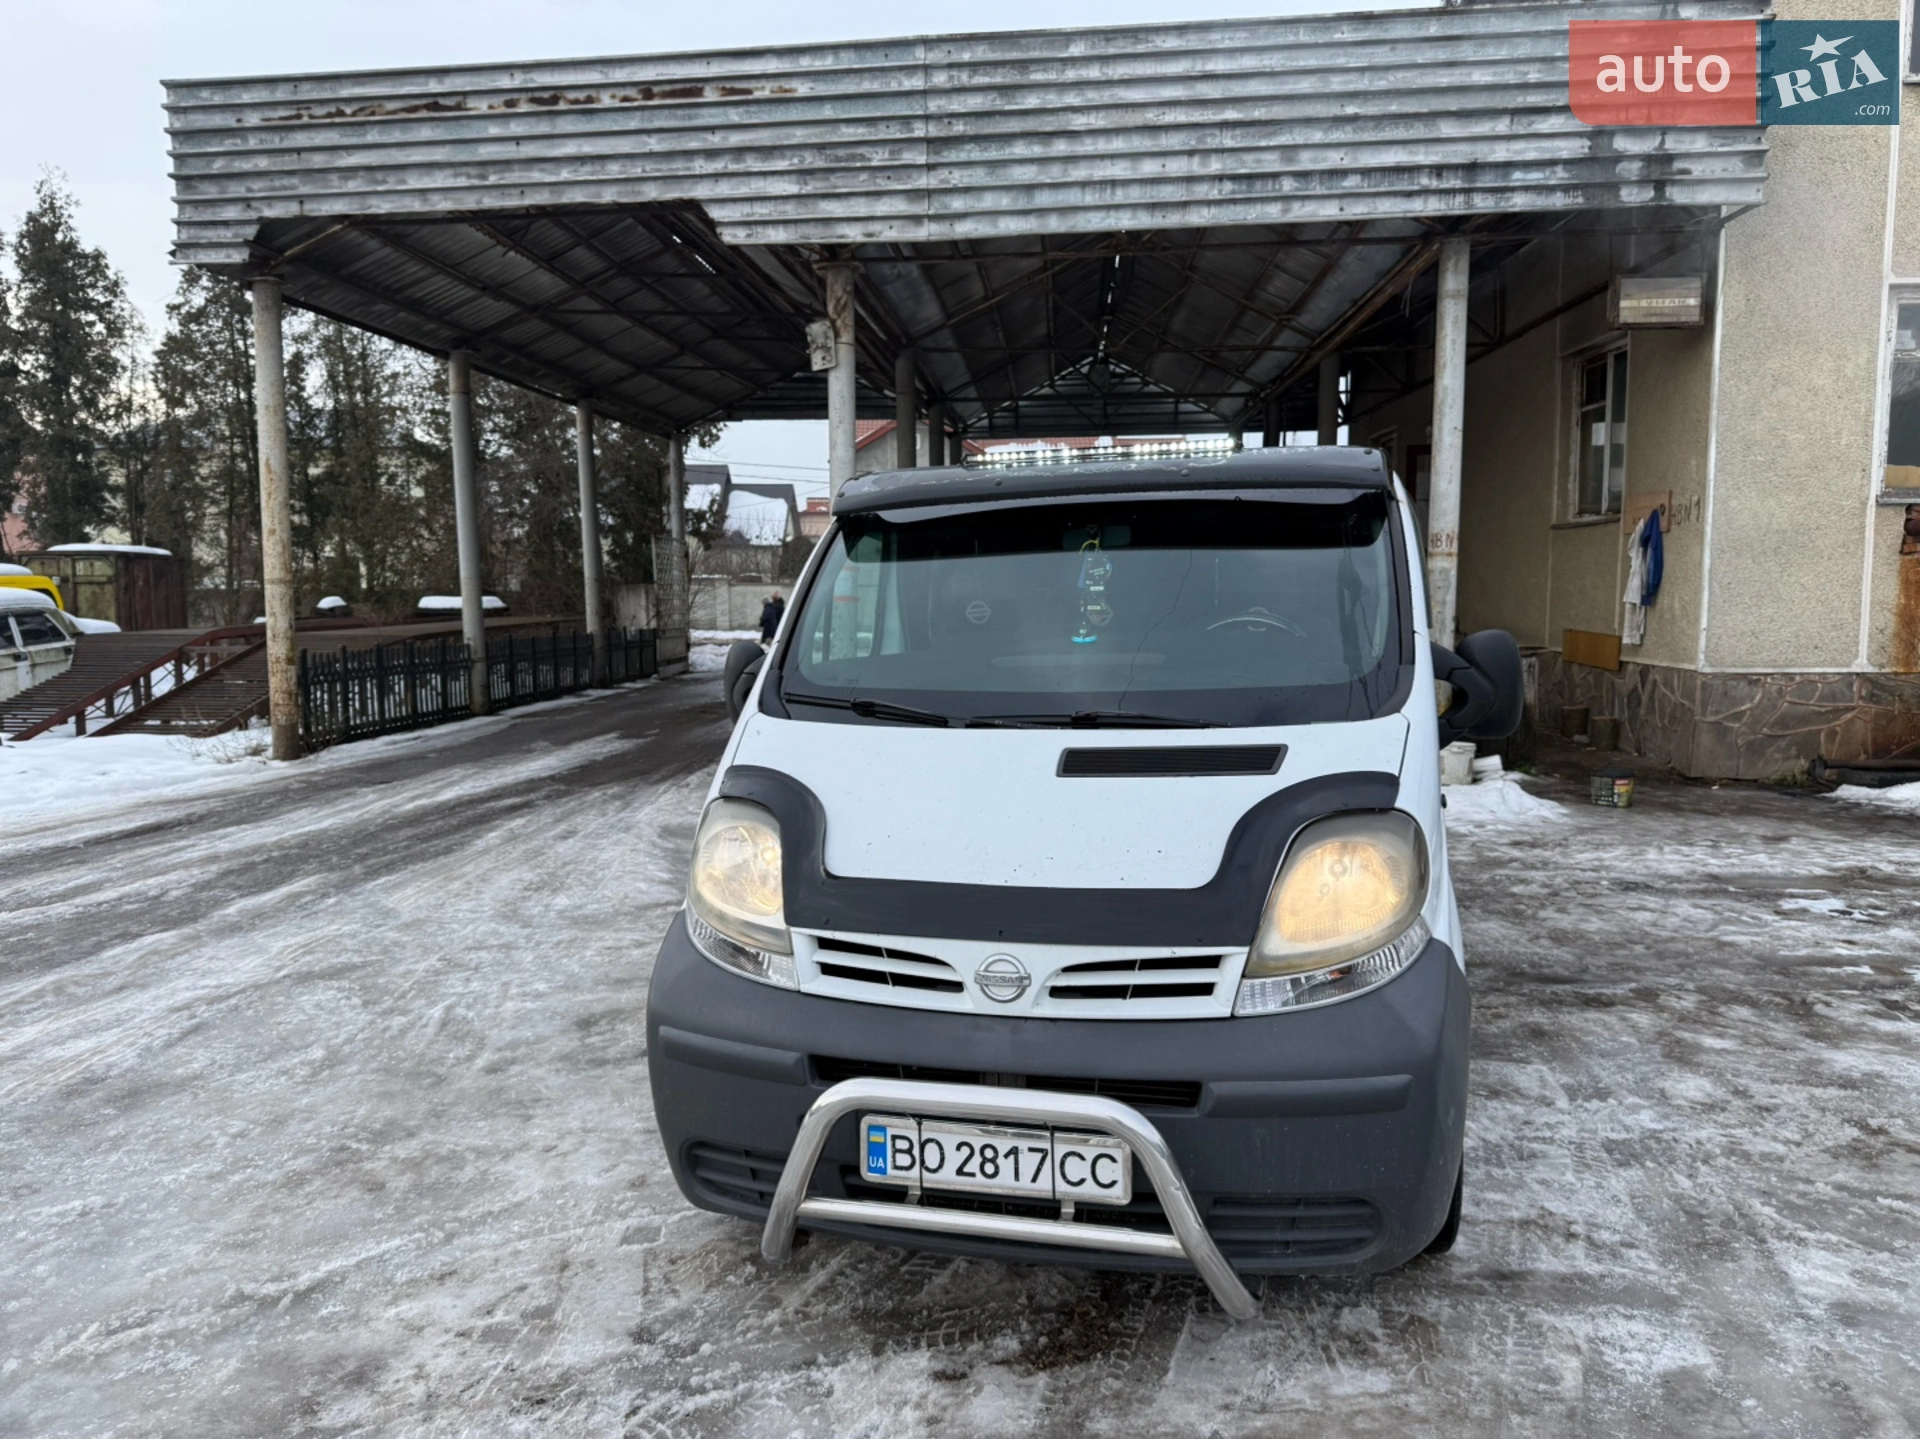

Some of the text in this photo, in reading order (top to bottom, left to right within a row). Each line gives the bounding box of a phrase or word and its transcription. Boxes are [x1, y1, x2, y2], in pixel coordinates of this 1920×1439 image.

[981, 975, 1024, 984] NISSAN
[869, 1155, 885, 1169] UA
[890, 1134, 1119, 1189] BO 2817 CC
